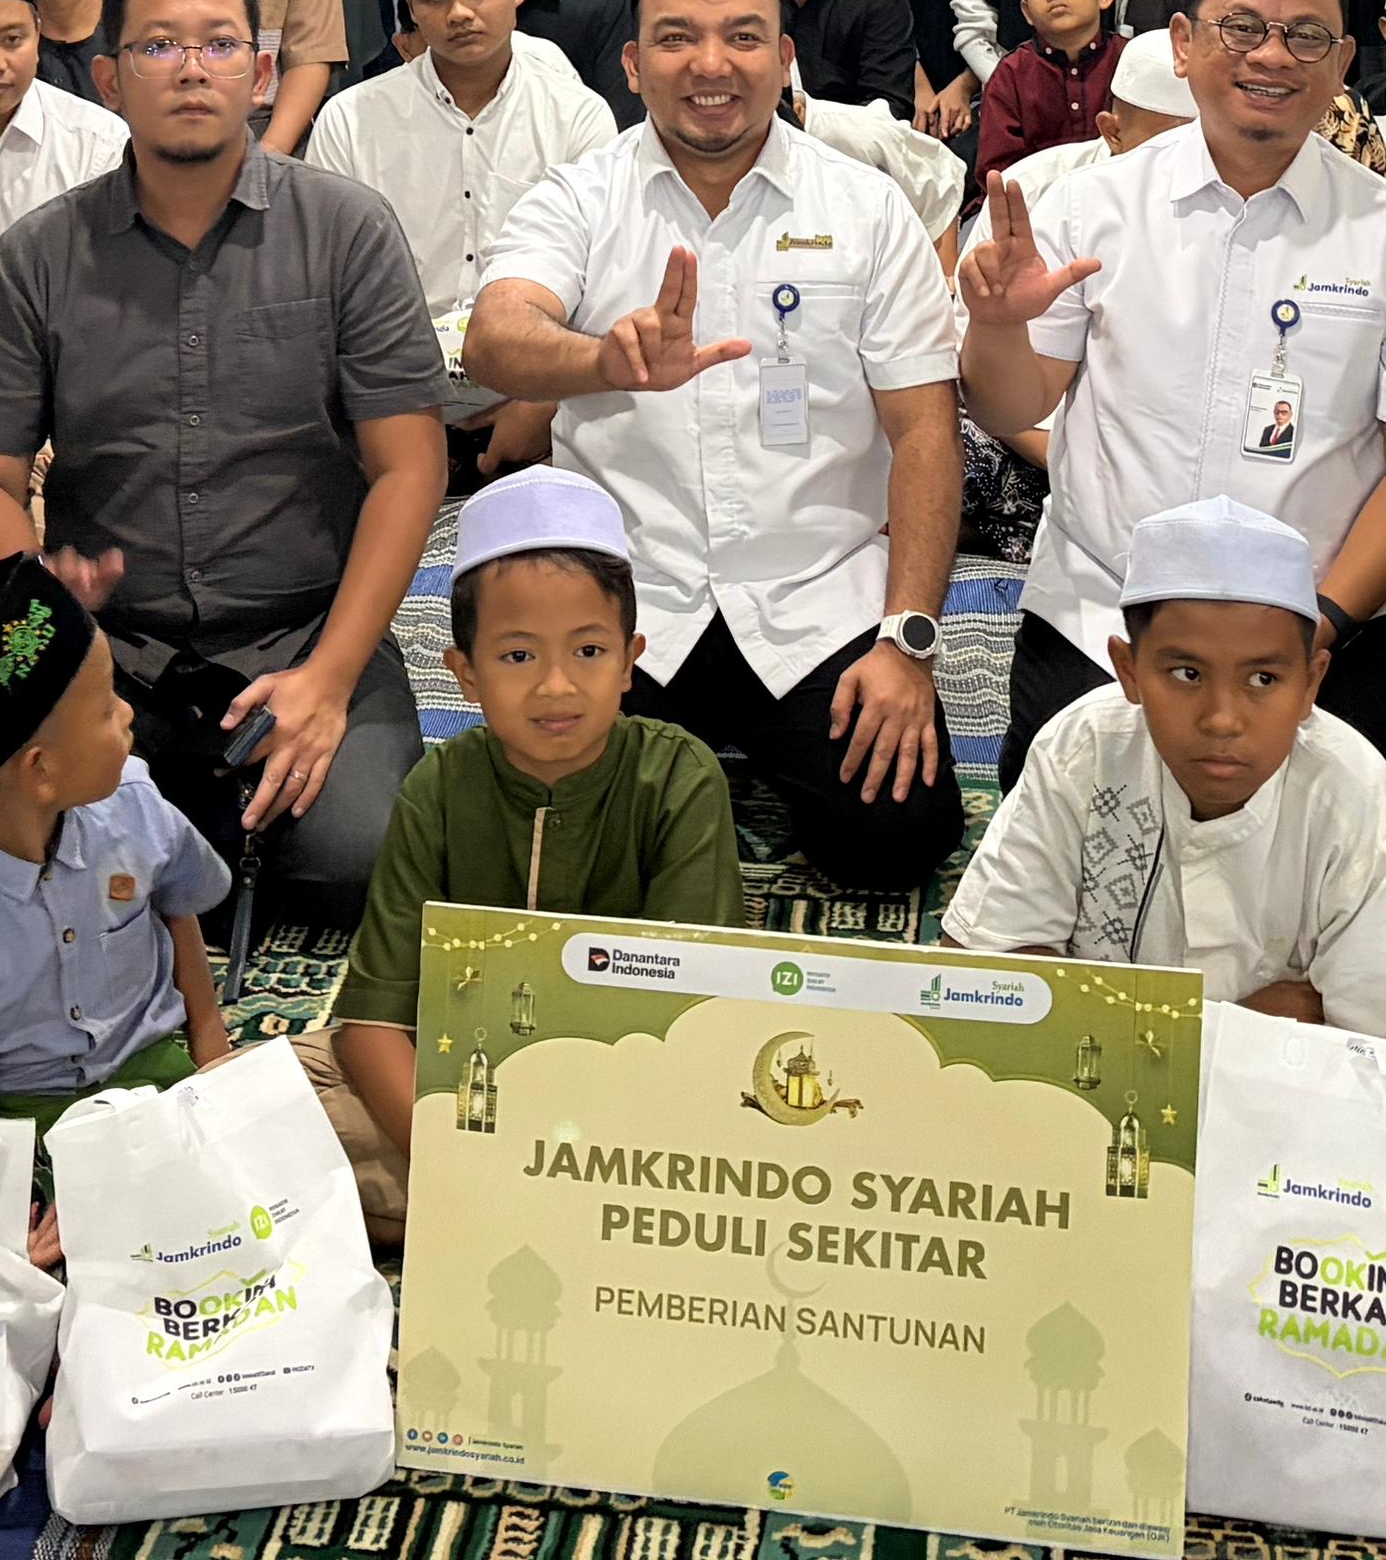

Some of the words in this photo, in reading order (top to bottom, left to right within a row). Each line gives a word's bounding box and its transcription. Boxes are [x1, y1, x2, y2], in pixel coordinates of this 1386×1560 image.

[1308, 283, 1369, 297] Jamkrindo
[613, 949, 680, 967] Danantara
[612, 962, 676, 979] Indonesia
[776, 971, 798, 986] IZI
[992, 980, 1025, 993] Syariah
[943, 987, 1024, 1007] Jamkrindo
[524, 1140, 832, 1205] JAMKRINDO
[851, 1171, 1071, 1230] SYARIAH
[1283, 1179, 1372, 1209] Jamkrindo
[155, 1235, 242, 1264] Jamkrindo
[601, 1204, 767, 1257] PEDULI
[786, 1222, 988, 1280] SEKITAR
[595, 1286, 787, 1333] PEMBERIAN
[795, 1307, 986, 1354] SANTUNAN
[204, 1386, 225, 1399] Center
